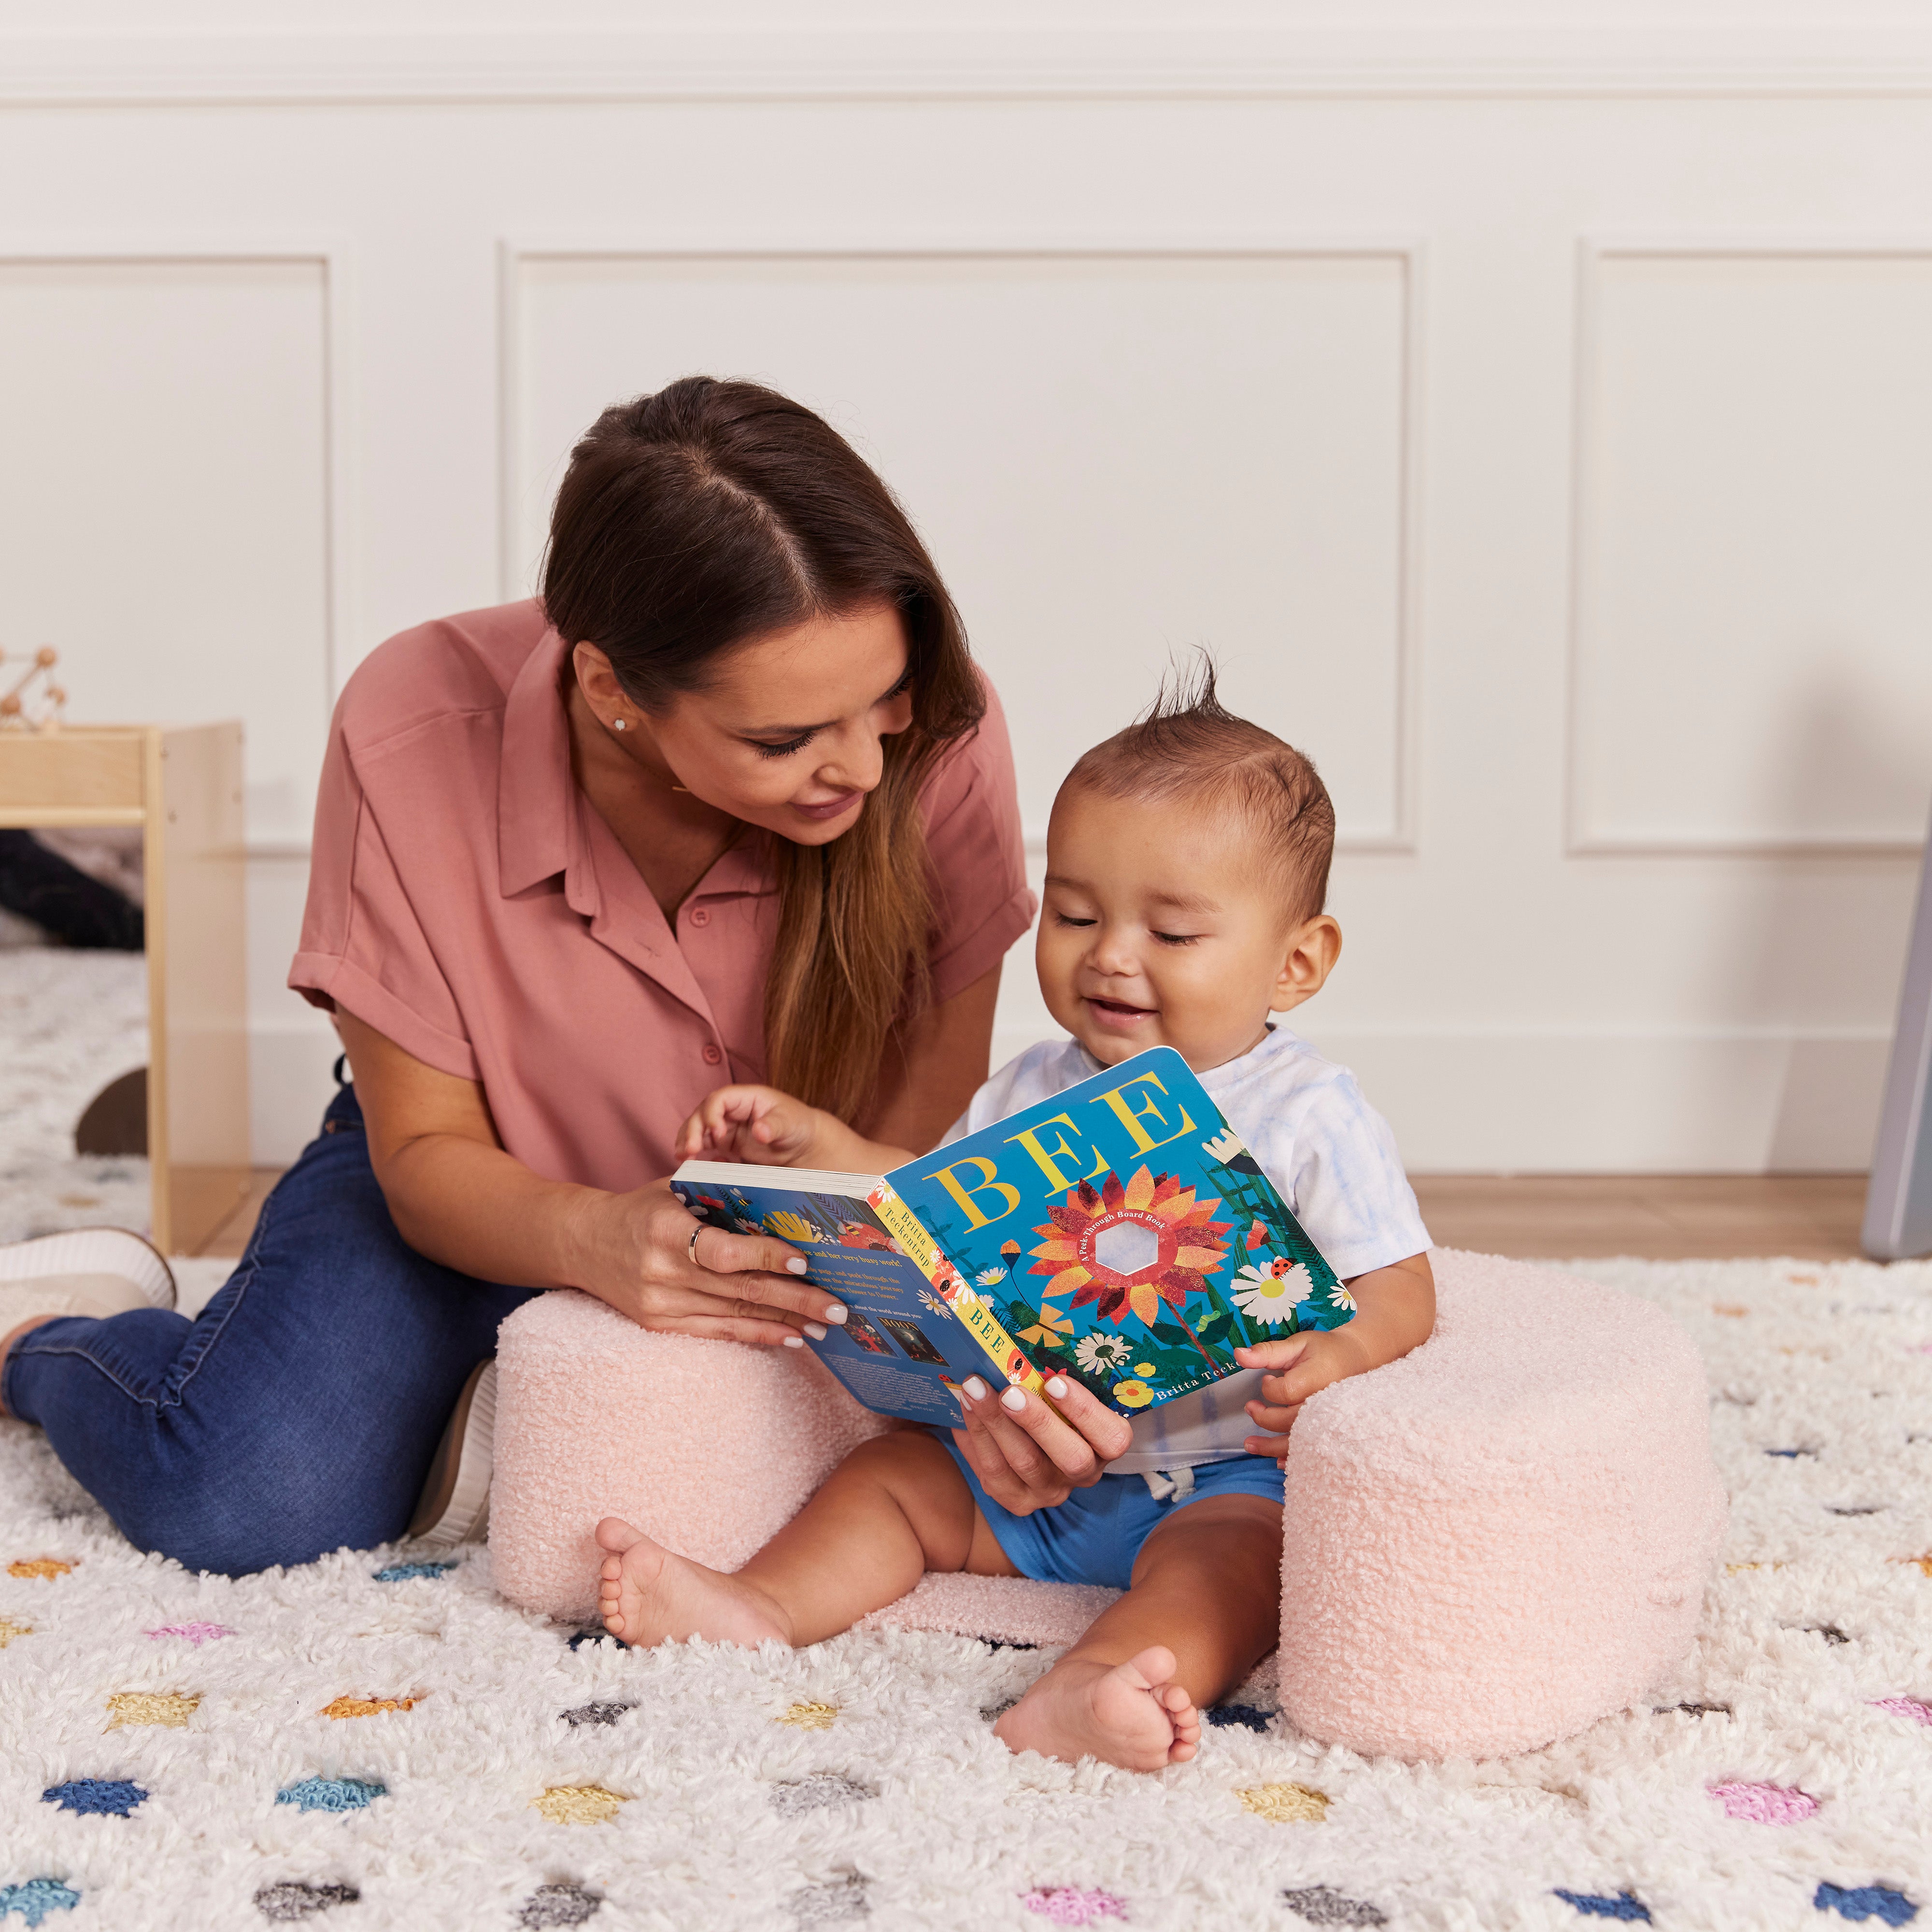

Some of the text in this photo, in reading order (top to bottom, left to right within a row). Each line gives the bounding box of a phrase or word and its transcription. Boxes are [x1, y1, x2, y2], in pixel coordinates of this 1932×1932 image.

[922, 1071, 1197, 1234] BEE
[884, 1207, 930, 1267] Teckentrup
[901, 1211, 926, 1246] Britta
[1079, 1214, 1115, 1255] Peek-Through
[1145, 1214, 1165, 1230] Book
[826, 1251, 841, 1260] her
[841, 1255, 859, 1263] very
[858, 1255, 879, 1266] busy
[879, 1259, 903, 1267] work!
[843, 1280, 879, 1289] miraculous
[878, 1284, 904, 1294] journey
[862, 1273, 889, 1283] through
[846, 1287, 867, 1295] flower
[875, 1291, 898, 1300] flower.
[878, 1318, 919, 1331] MOON
[969, 1307, 1005, 1353] BEE
[1154, 1378, 1199, 1401] Britta
